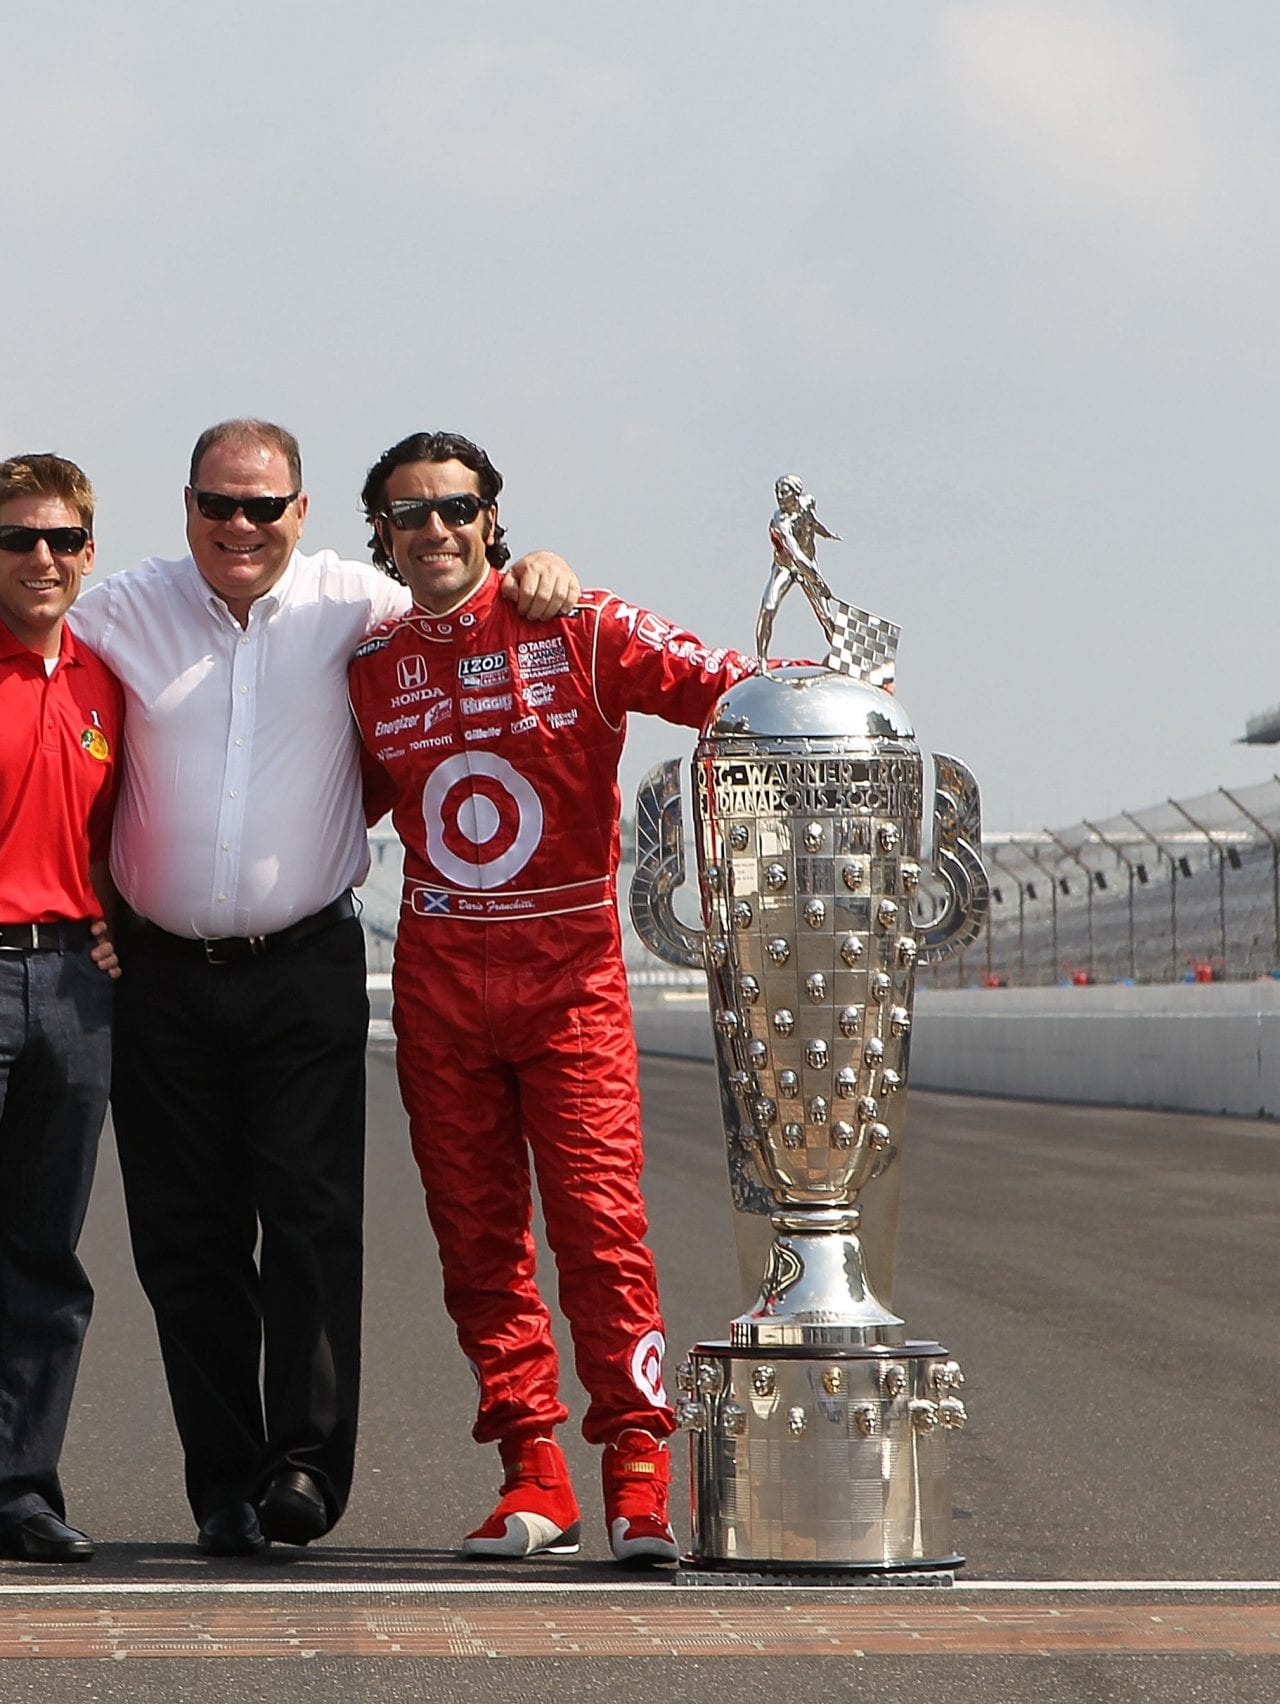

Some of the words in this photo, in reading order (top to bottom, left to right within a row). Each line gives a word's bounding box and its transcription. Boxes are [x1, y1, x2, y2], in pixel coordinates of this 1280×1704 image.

[527, 636, 562, 651] TARGET
[462, 655, 504, 674] IZOD
[391, 687, 445, 708] HONDA
[375, 714, 420, 737] Energizer
[464, 726, 501, 740] Gillette
[708, 787, 829, 815] DIANAPOLIS
[458, 899, 484, 911] Dario
